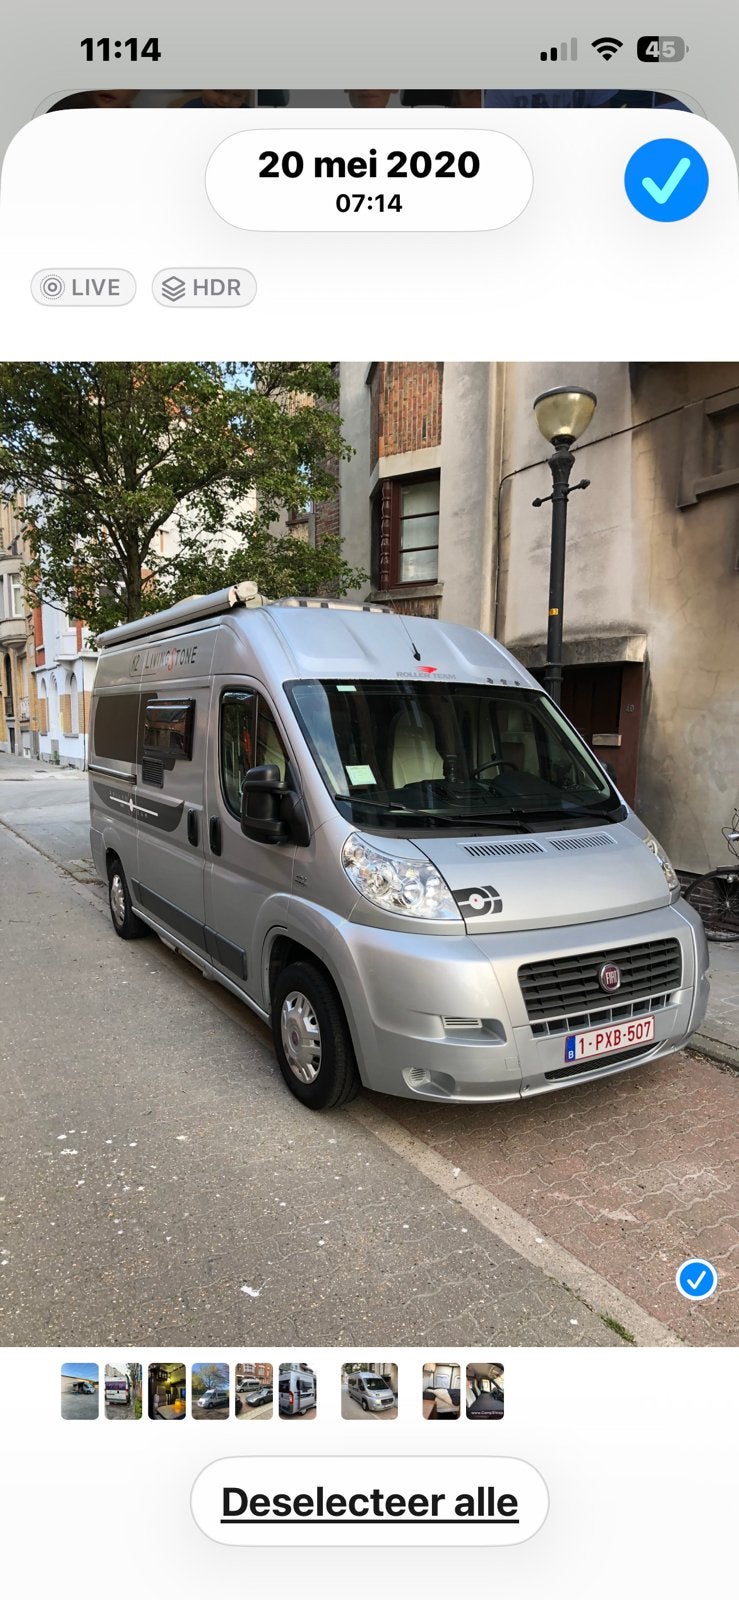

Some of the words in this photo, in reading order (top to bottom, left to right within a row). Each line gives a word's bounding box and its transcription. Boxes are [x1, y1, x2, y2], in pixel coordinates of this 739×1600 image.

[80, 38, 162, 61] 11:14
[645, 41, 676, 58] 45
[258, 150, 305, 179] 20
[314, 148, 378, 179] mei
[386, 150, 481, 179] 2020
[335, 193, 403, 214] 07:14
[72, 278, 121, 296] LIVE
[193, 278, 242, 296] HDR
[396, 671, 431, 679] ROLLER
[433, 672, 457, 680] TEAM
[605, 970, 618, 985] FIAT
[568, 1050, 574, 1060] B
[578, 1020, 652, 1055] 1-PXB-507
[222, 1486, 446, 1517] Deselecteer
[453, 1486, 519, 1517] alle
